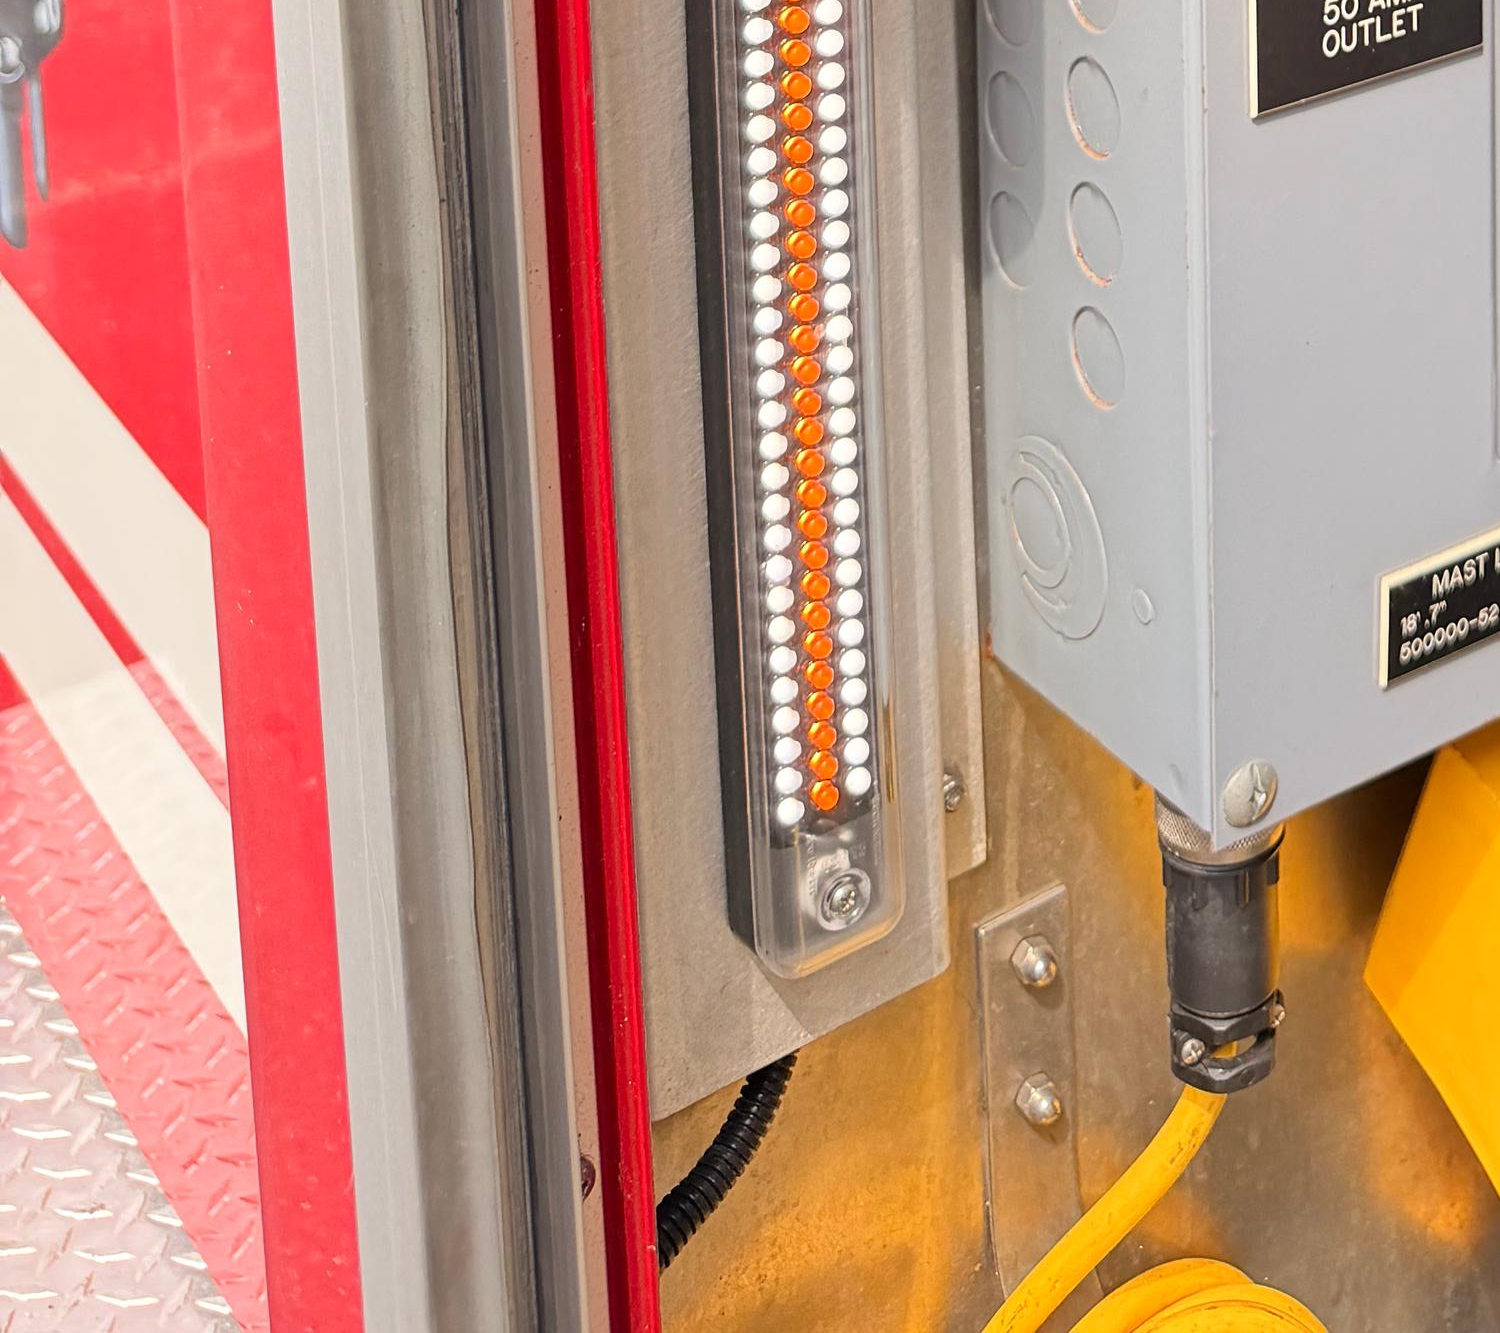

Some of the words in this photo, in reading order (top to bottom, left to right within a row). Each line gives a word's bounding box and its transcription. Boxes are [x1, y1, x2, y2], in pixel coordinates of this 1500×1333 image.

[1322, 4, 1423, 58] OUTLET
[1432, 552, 1489, 599] MAST
[1399, 603, 1500, 665] 500000-52
